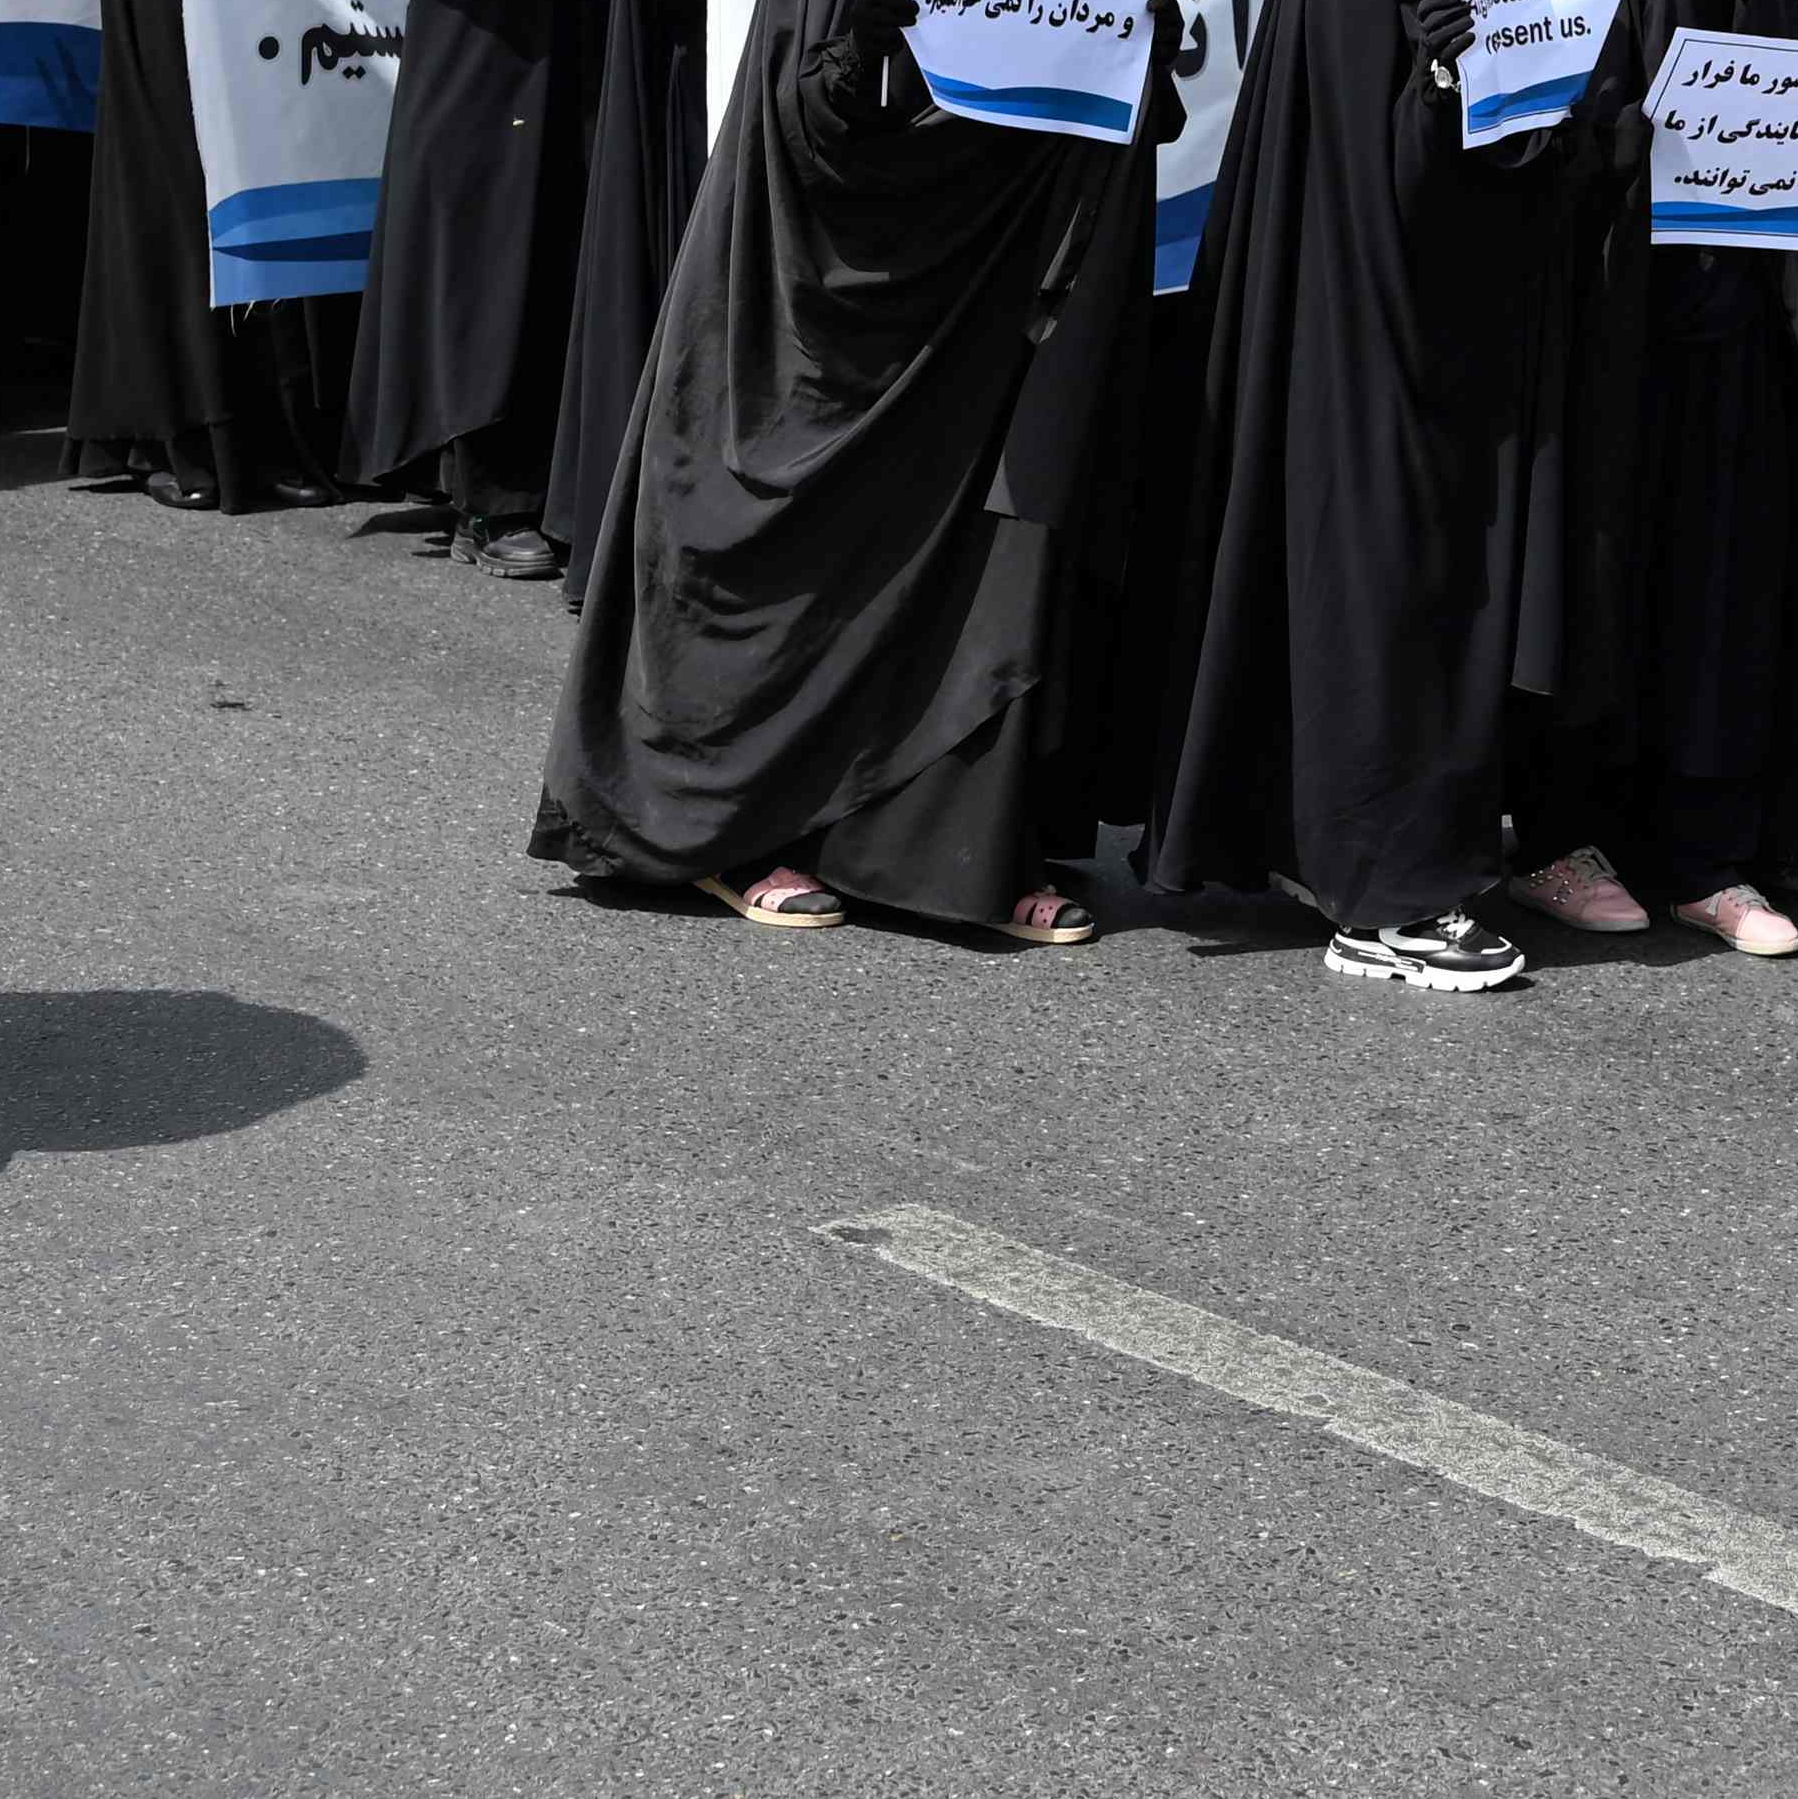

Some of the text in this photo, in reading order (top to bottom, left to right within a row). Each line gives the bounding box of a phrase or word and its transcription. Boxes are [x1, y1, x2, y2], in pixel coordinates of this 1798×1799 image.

[1117, 14, 1135, 39] و
[1560, 14, 1592, 39] us.
[1681, 59, 1736, 89] فرار
[1738, 62, 1761, 87] ما
[1663, 109, 1687, 132] ما
[1687, 114, 1718, 140] از
[1749, 170, 1796, 196] نمی
